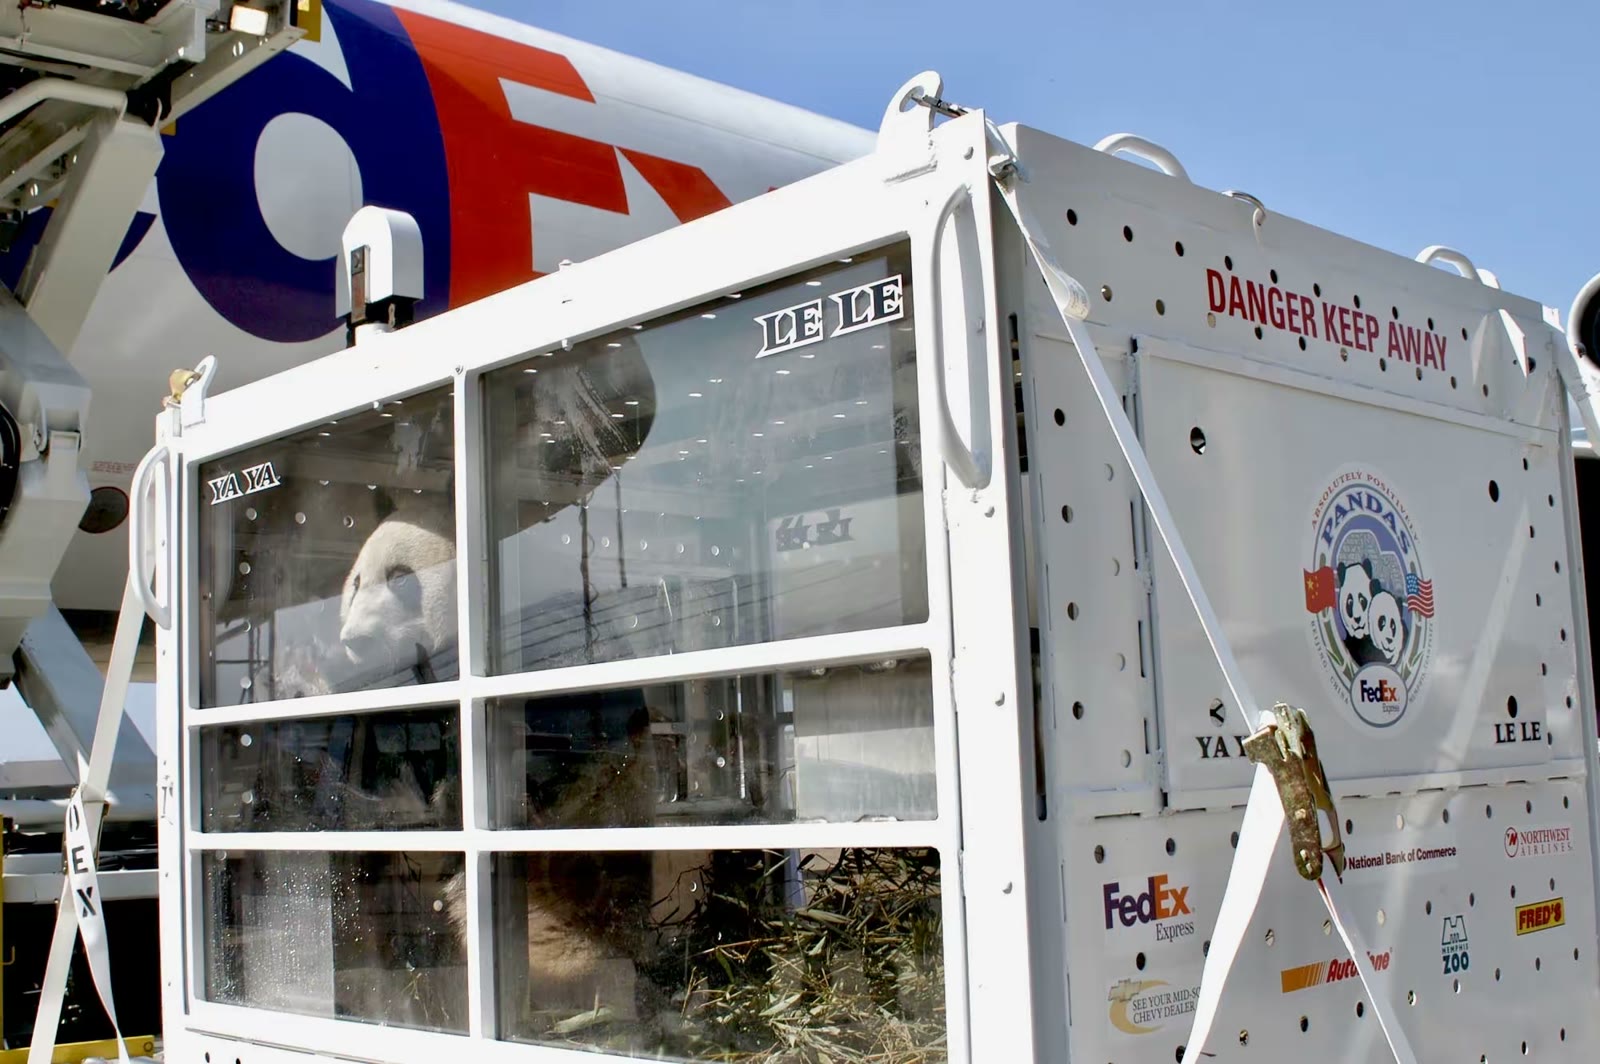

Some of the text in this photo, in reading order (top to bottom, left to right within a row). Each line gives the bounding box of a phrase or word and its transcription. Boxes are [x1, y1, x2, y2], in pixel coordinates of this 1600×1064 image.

[754, 274, 904, 359] LE LE
[1206, 268, 1447, 371] DANGER KEEP AWAY
[208, 452, 281, 505] YA YA
[1311, 471, 1363, 531] ABSOLUTELY
[1321, 491, 1411, 555] PANDAS
[1360, 680, 1397, 702] FedEx
[1494, 721, 1541, 743] LE LE
[1195, 735, 1250, 759] YA Y
[1520, 828, 1571, 845] NORTHWEST
[1348, 846, 1457, 870] National Bank of Commerce
[1520, 842, 1572, 857] AIRLINES
[1103, 873, 1191, 930] FedEx
[1518, 902, 1562, 930] FRED'S
[1156, 921, 1195, 943] Express
[1441, 943, 1469, 954] MEMPHIS
[1442, 951, 1470, 975] ZOO
[1132, 998, 1147, 1011] SEE
[1148, 992, 1172, 1008] YOUR
[1133, 1007, 1163, 1024] CHEVY
